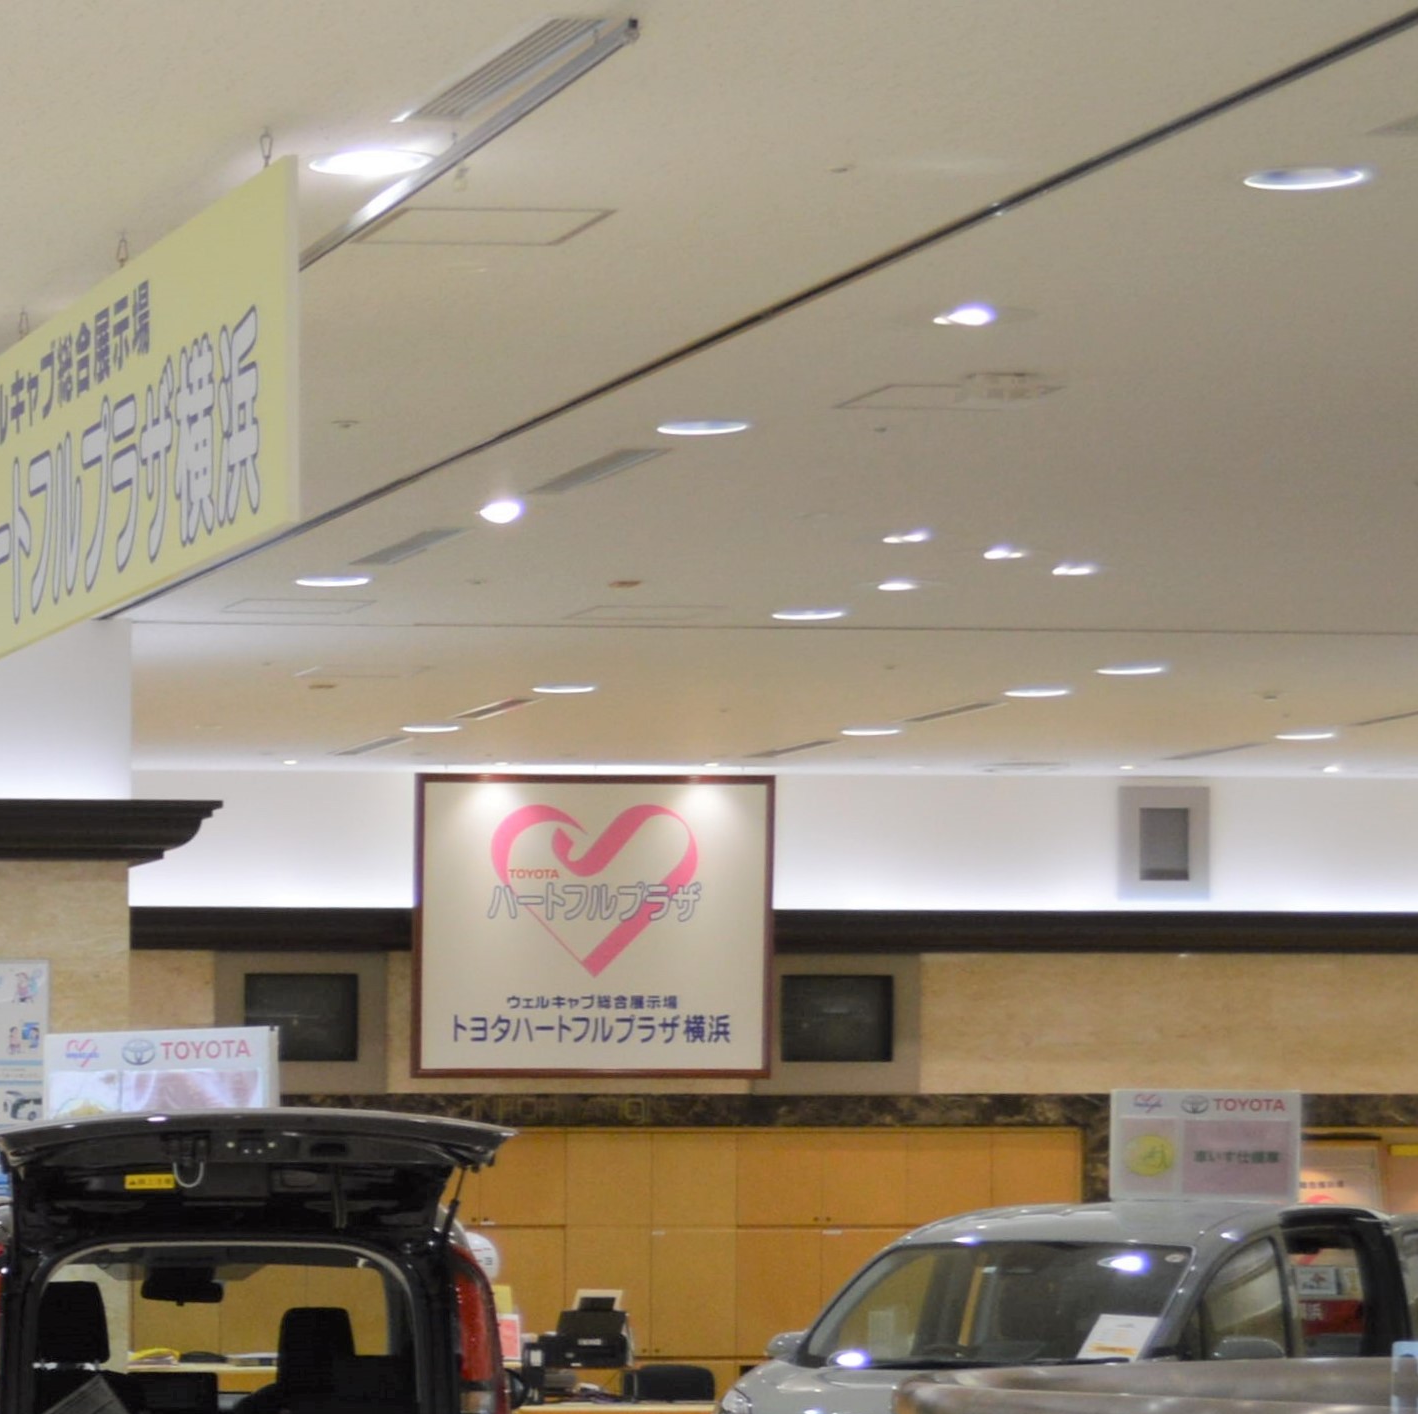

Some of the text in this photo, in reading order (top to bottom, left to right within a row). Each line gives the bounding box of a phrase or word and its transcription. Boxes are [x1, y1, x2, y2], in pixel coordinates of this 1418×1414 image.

[508, 868, 560, 880] TOYOTA
[487, 882, 702, 922] ハートフルプラザ
[506, 994, 678, 1010] ウェルキャブ総合展示場
[452, 1013, 731, 1044] トヨタハートフルプラザ横浜
[160, 1038, 252, 1061] TOYOTA
[1212, 1098, 1286, 1112] TOYOTA
